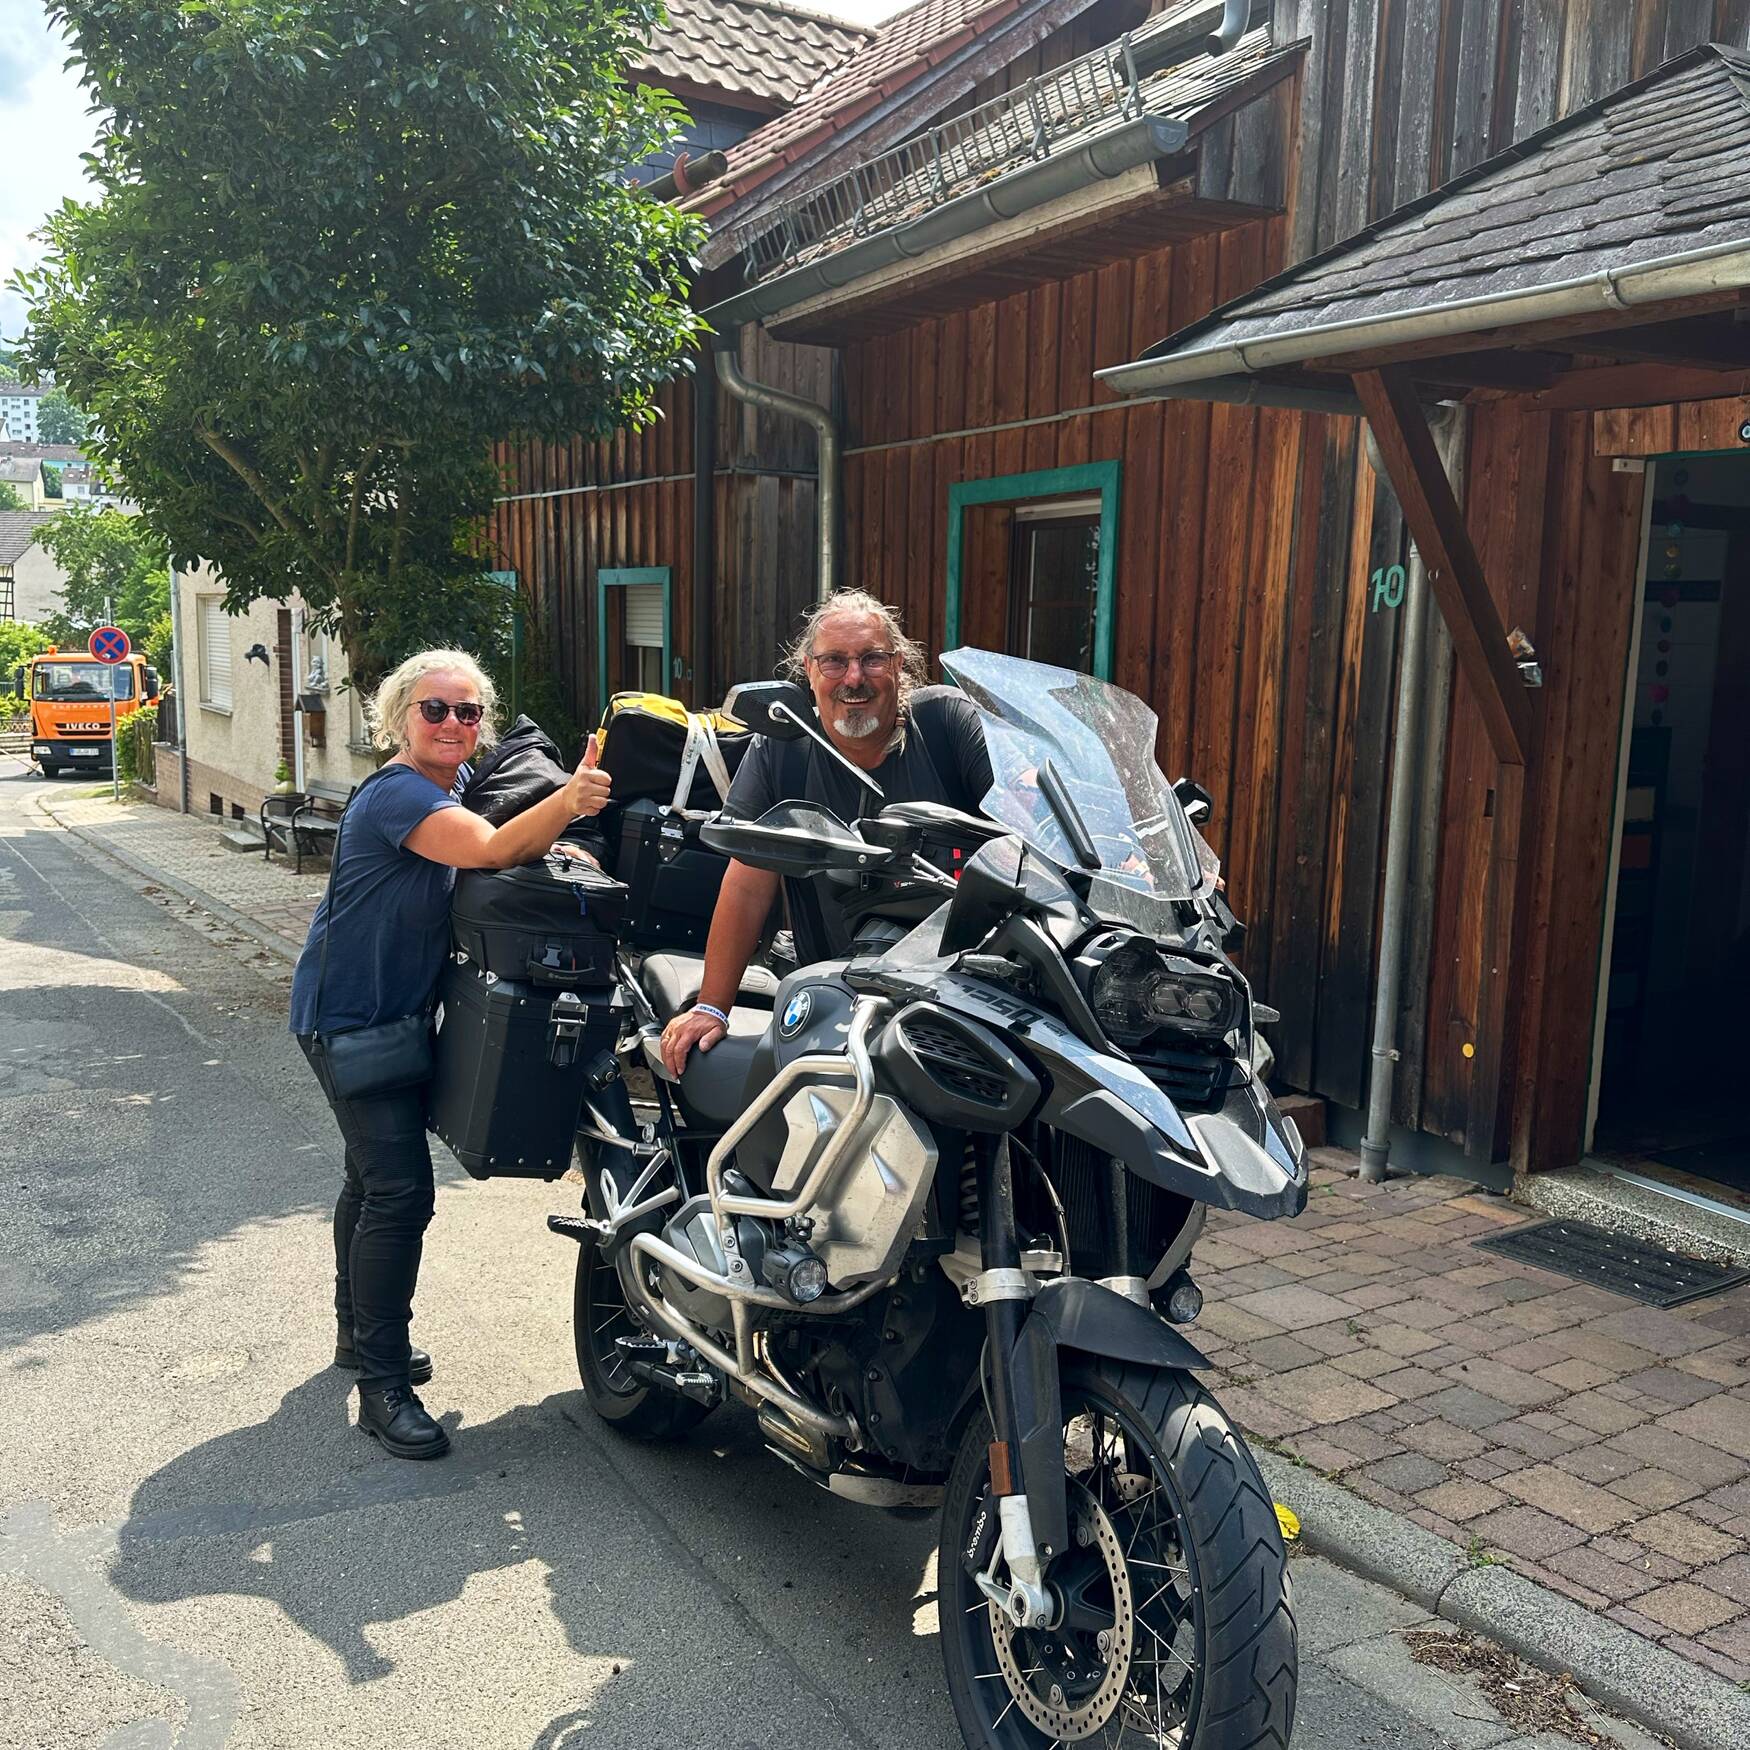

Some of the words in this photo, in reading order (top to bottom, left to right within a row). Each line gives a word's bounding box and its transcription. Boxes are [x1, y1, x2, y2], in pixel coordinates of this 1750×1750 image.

[1371, 565, 1405, 612] 10
[960, 984, 1044, 1026] 1250
[966, 1511, 987, 1559] brembo
